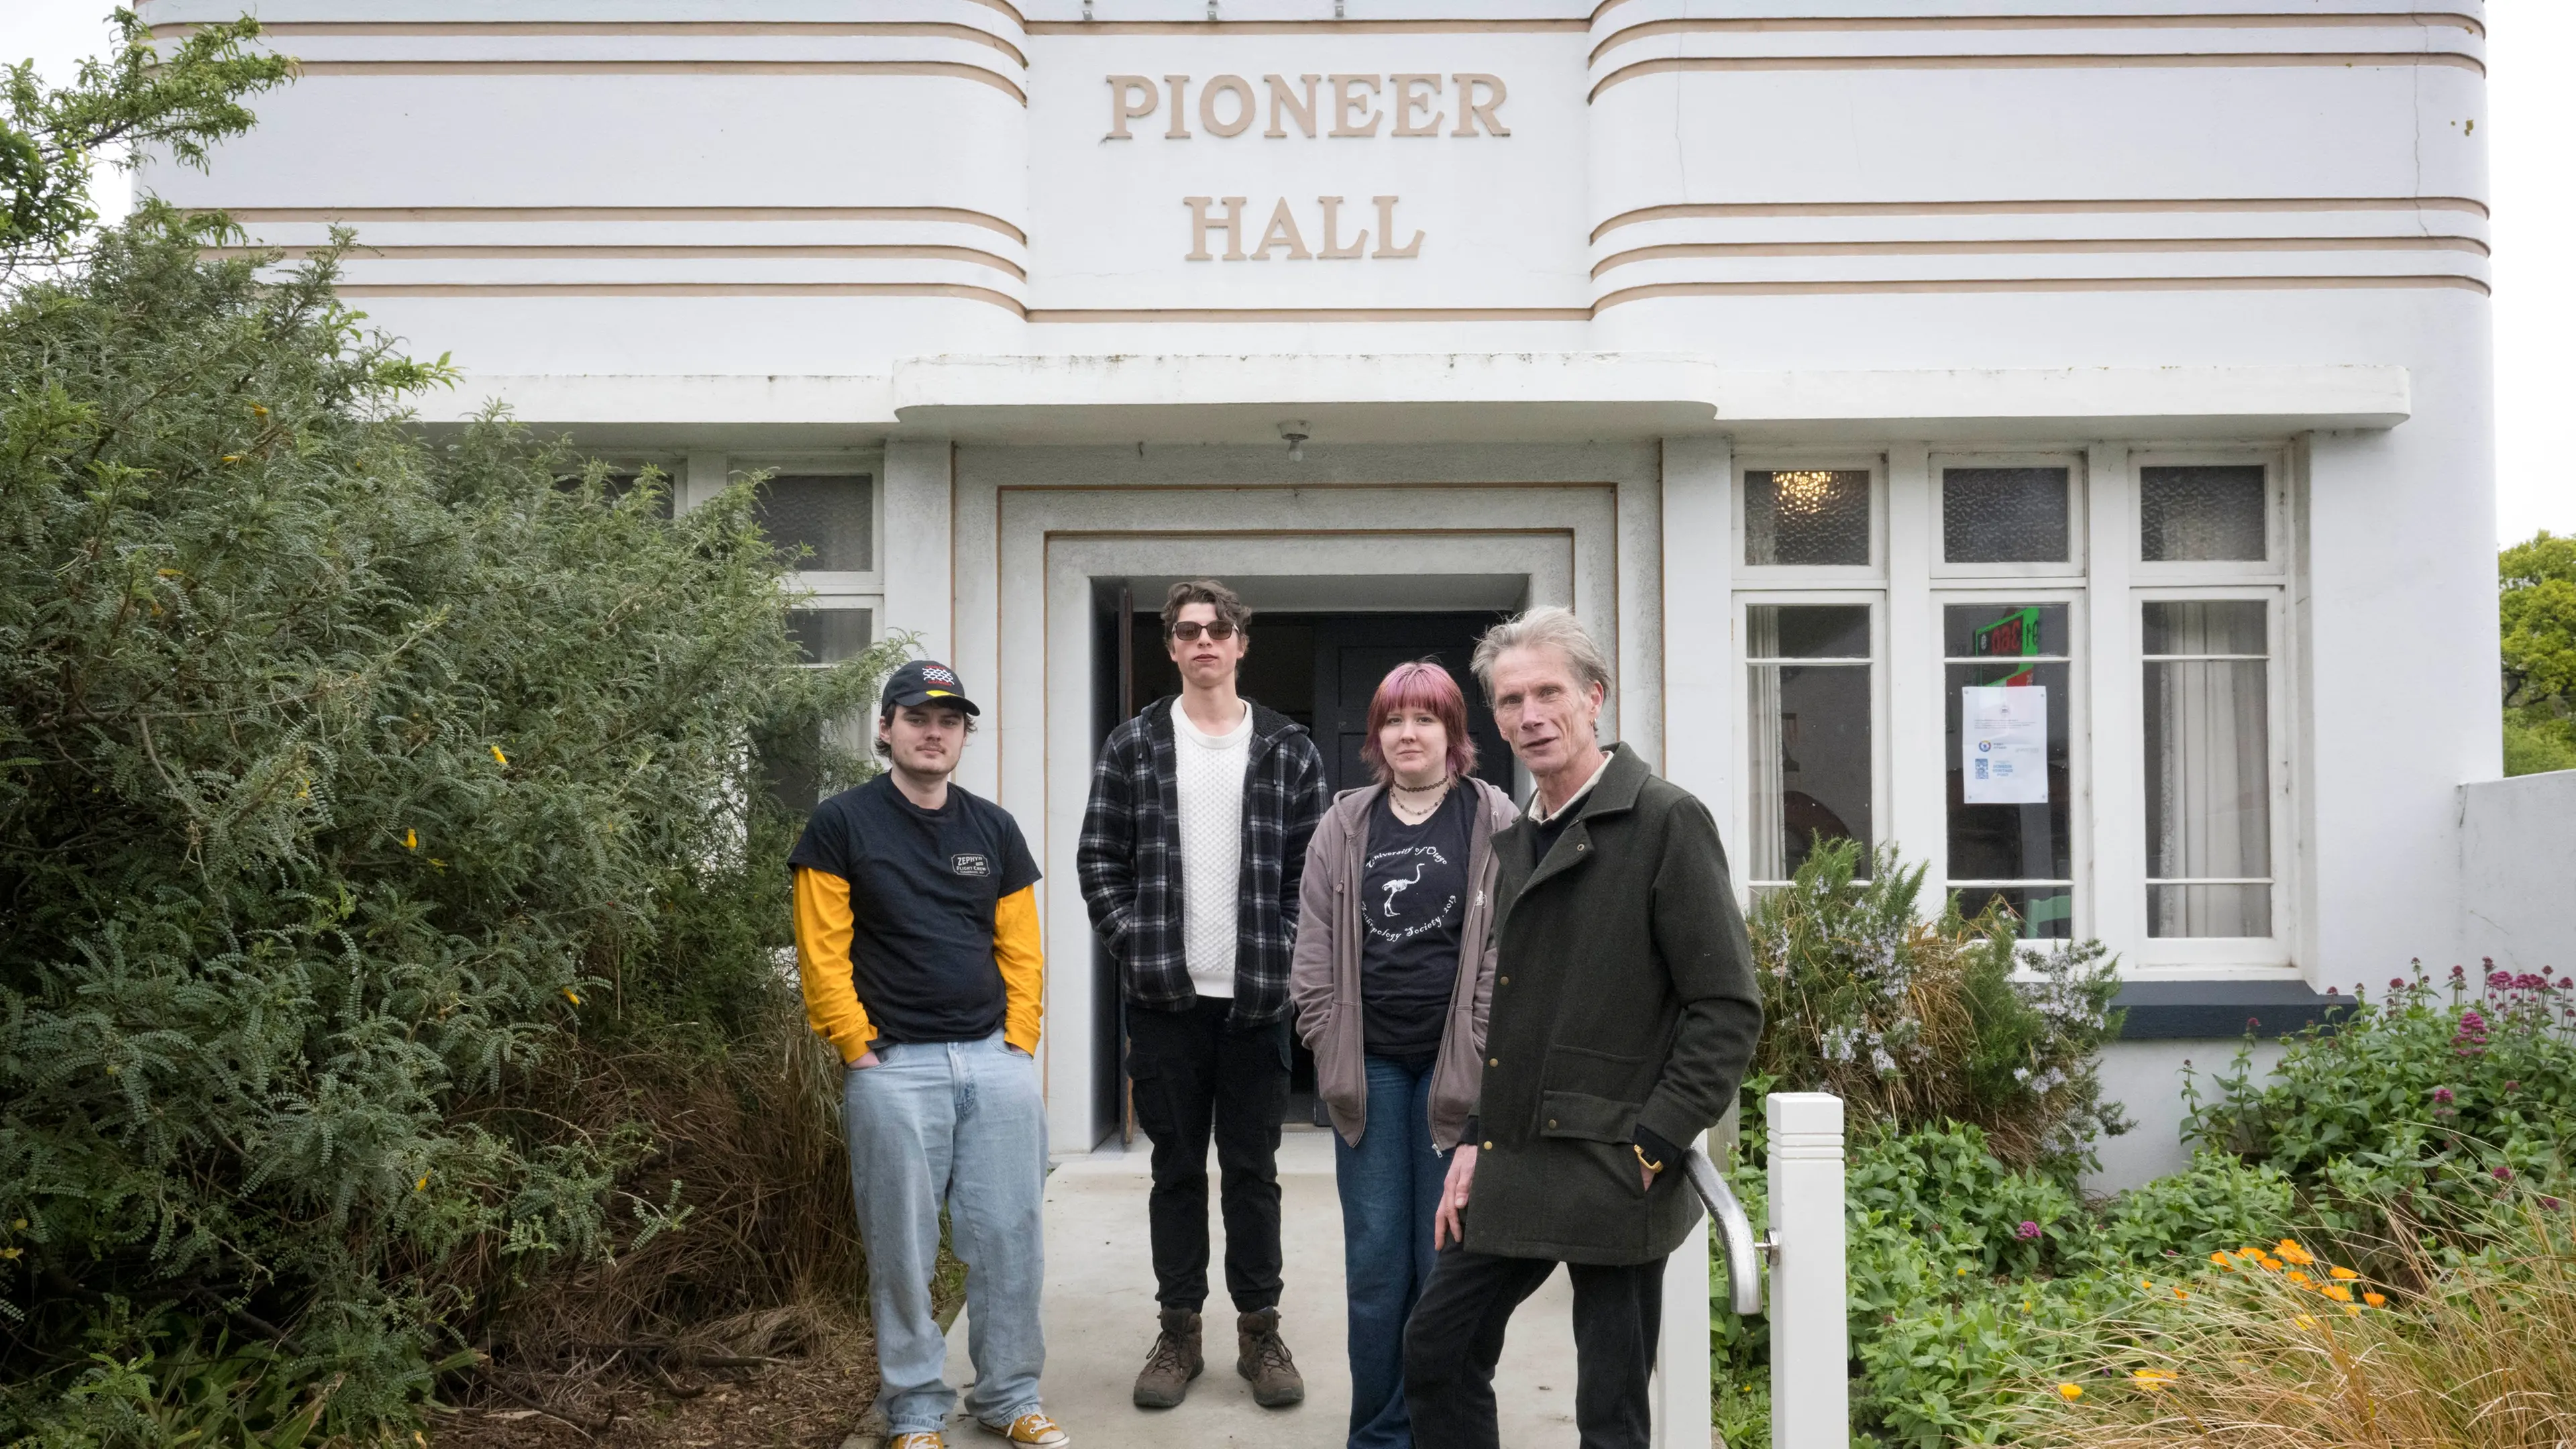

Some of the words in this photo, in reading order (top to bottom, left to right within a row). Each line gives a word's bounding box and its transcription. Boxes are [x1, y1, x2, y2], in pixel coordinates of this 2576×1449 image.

[1106, 72, 1511, 140] PIONEER
[1183, 195, 1426, 261] HALL
[957, 856, 983, 866] ZEPHYR
[1365, 846, 1413, 868] University
[1415, 846, 1428, 856] of
[1426, 846, 1448, 865] Otago
